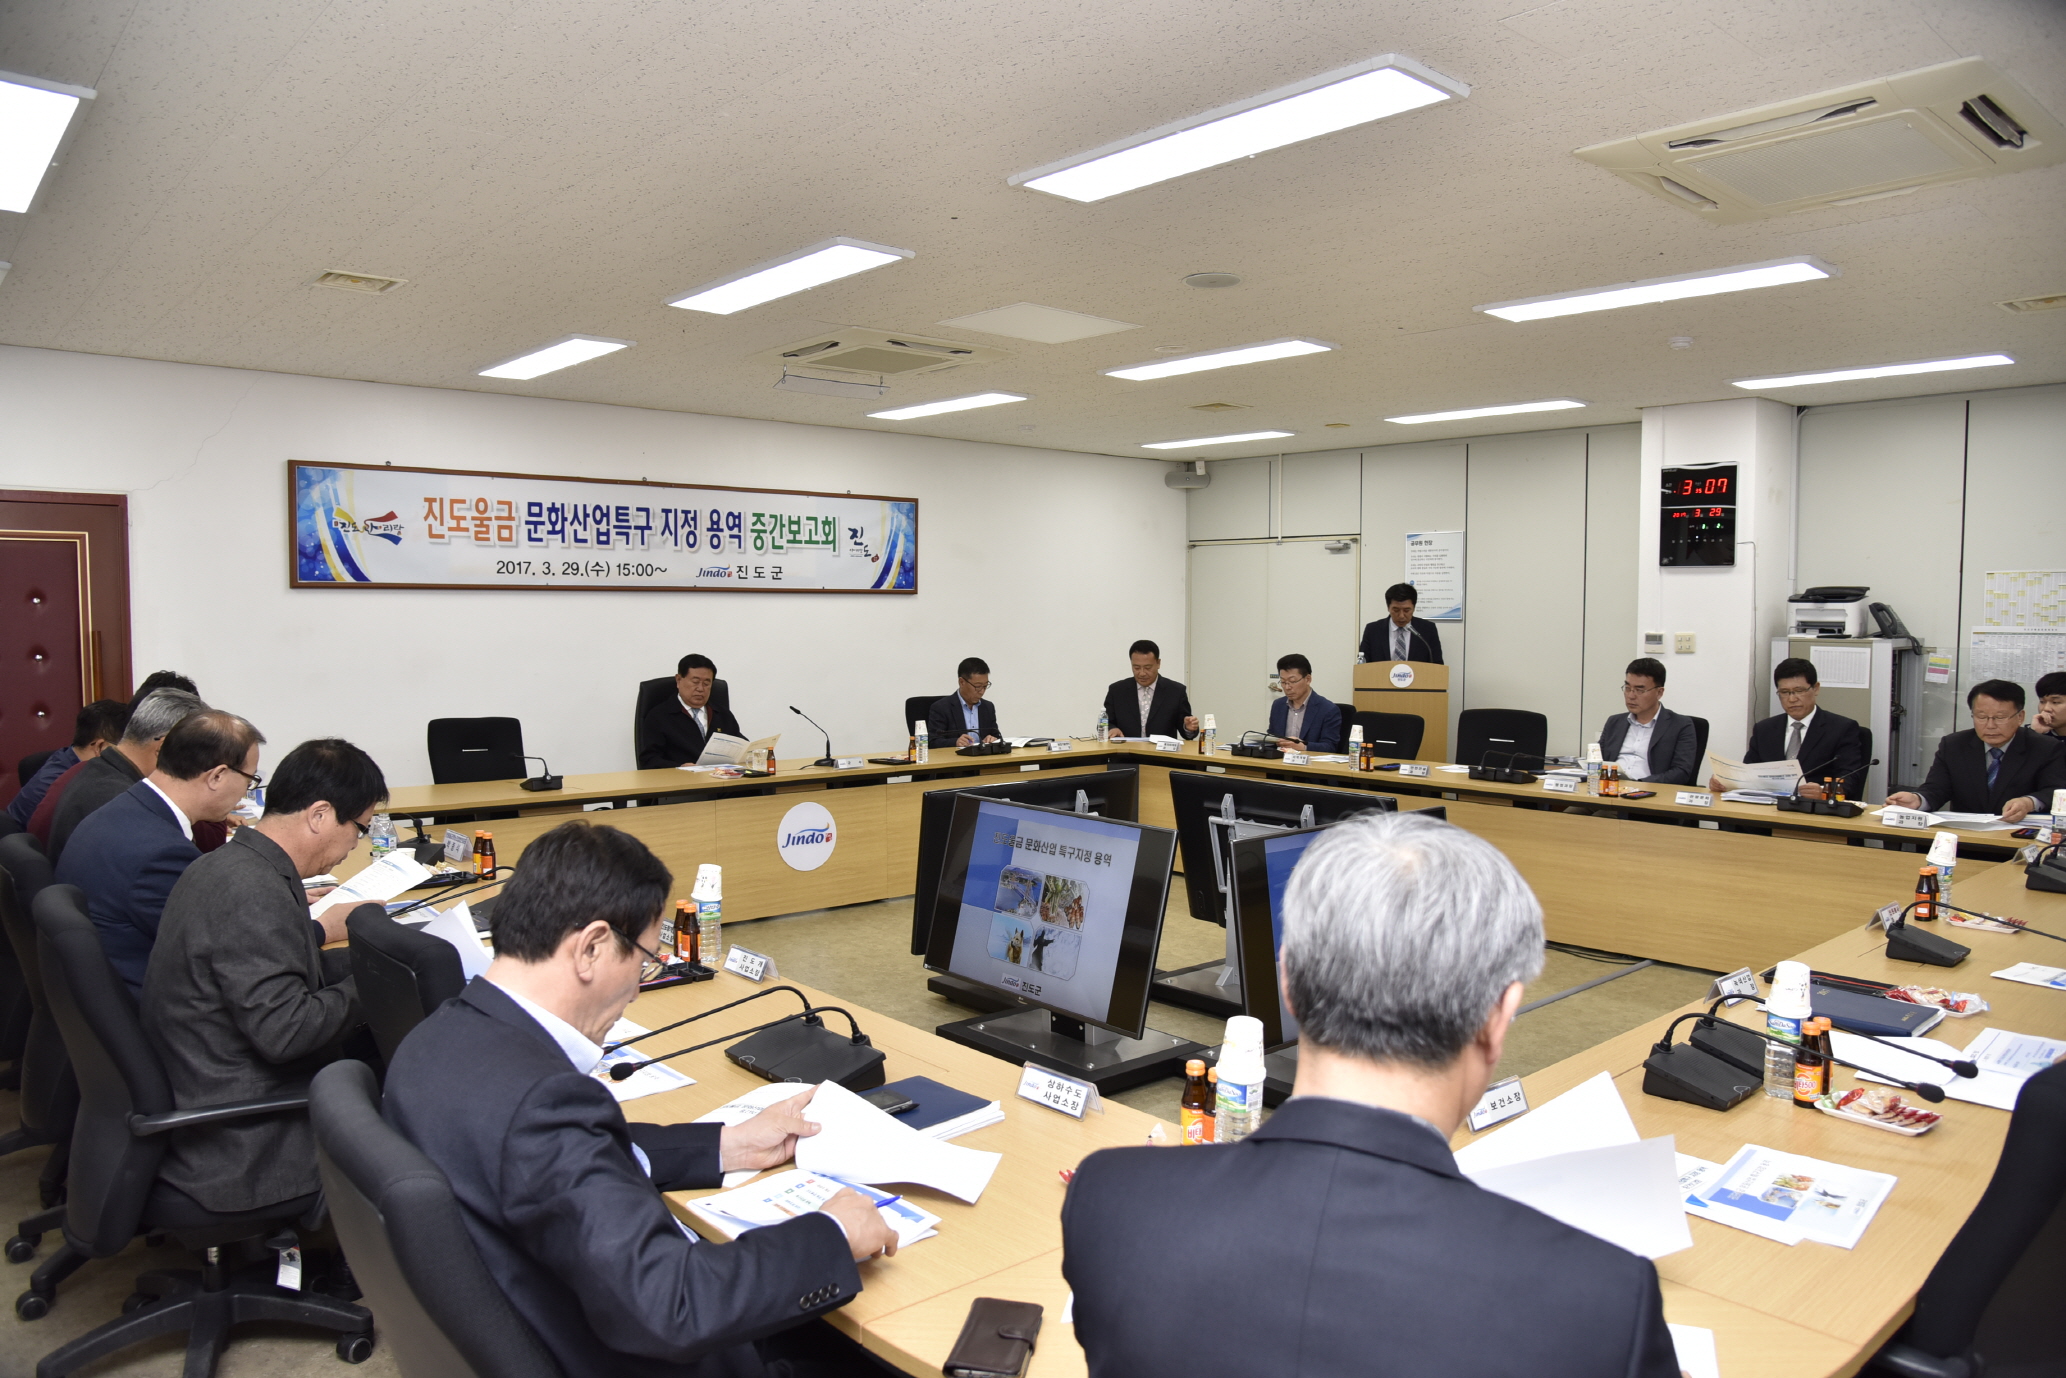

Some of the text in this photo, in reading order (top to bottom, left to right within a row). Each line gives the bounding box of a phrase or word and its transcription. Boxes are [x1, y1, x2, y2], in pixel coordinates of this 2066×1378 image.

[1705, 478, 1728, 494] 07
[1709, 507, 1722, 517] 29
[423, 497, 837, 552] 진도울금 문화산업특구 지정 용역 중간보고회
[496, 560, 668, 577] 2017. 3. 29.(수) 15:00~
[696, 566, 728, 578] Jindo
[782, 831, 825, 848] Jindo
[1025, 838, 1057, 856] 문화산업
[1059, 845, 1092, 863] 특구지정
[1094, 852, 1112, 867] 용역
[1022, 981, 1042, 996] 진도군
[1047, 1079, 1082, 1098] 상하수도
[1043, 1091, 1079, 1111] 사업소장
[1490, 1092, 1521, 1111] 보건소장
